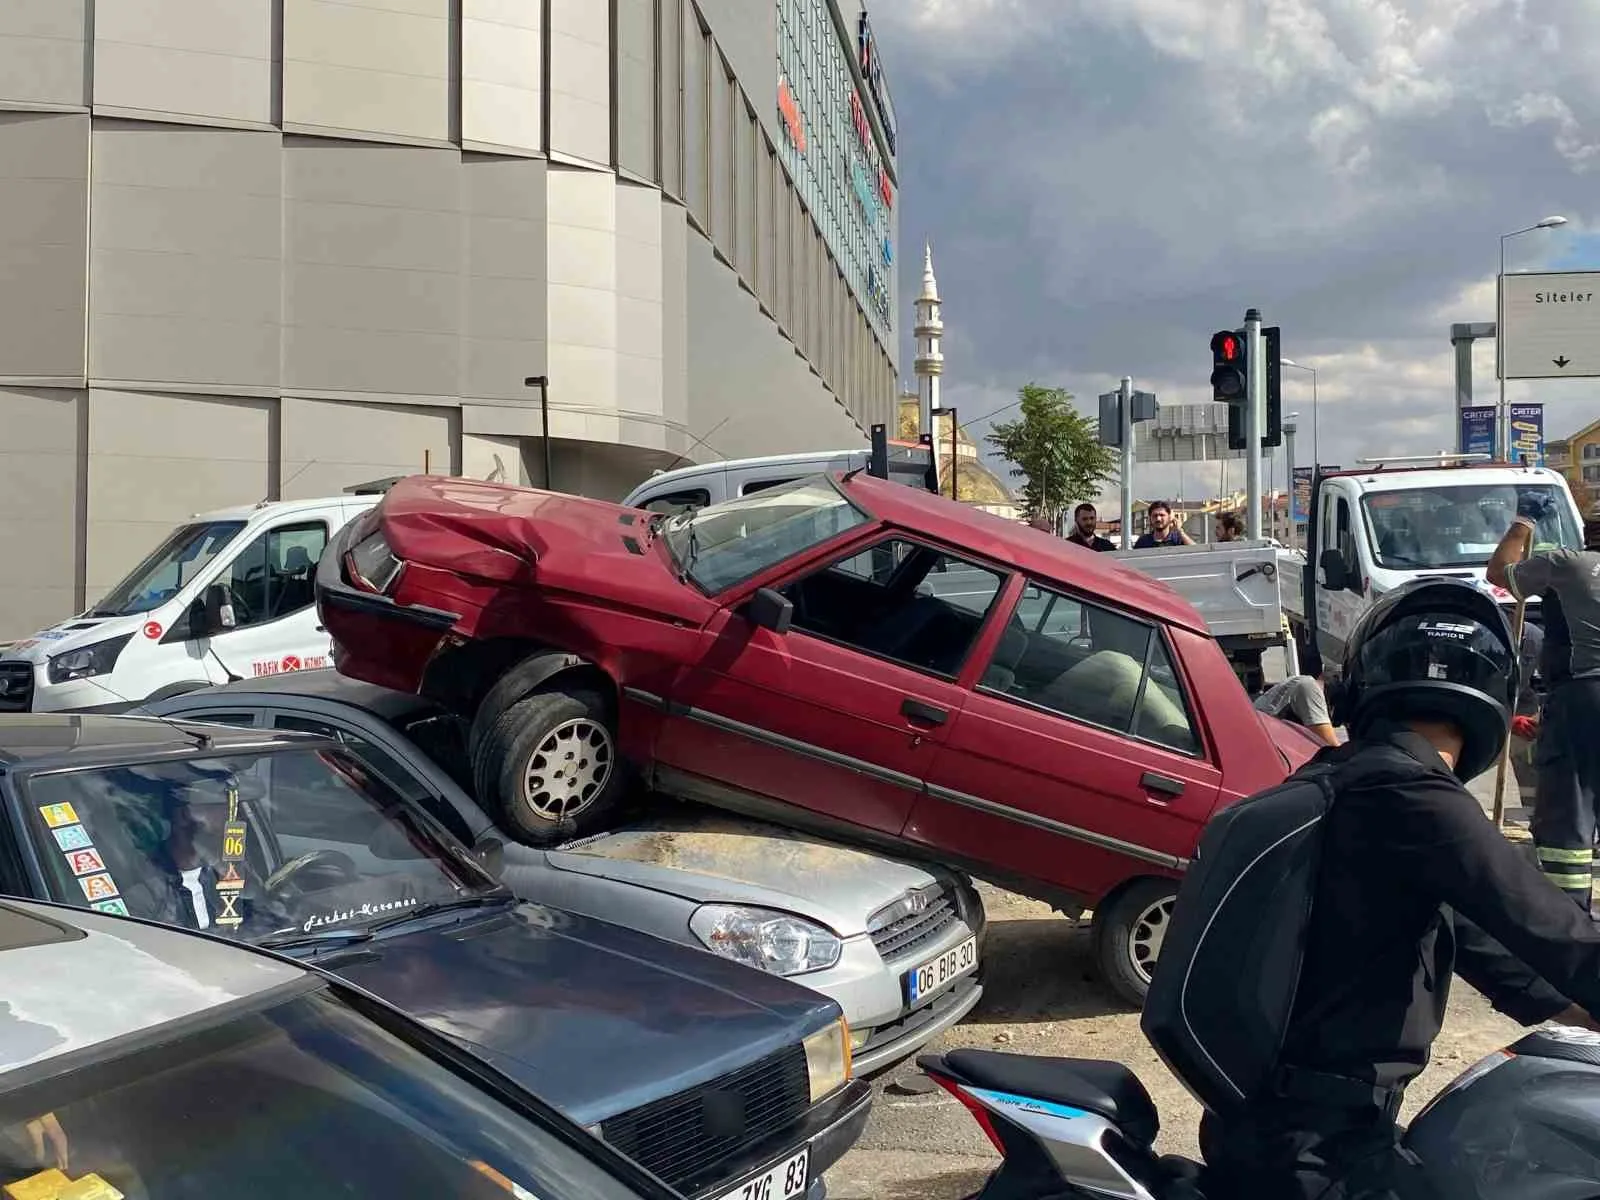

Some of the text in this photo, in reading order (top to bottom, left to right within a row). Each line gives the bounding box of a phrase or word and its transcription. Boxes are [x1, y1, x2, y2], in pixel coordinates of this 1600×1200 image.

[1535, 292, 1593, 303] Siteler
[1417, 621, 1475, 635] LS2
[225, 836, 243, 856] 06
[919, 941, 973, 994] 06 BIB 30
[784, 1154, 806, 1196] 83
